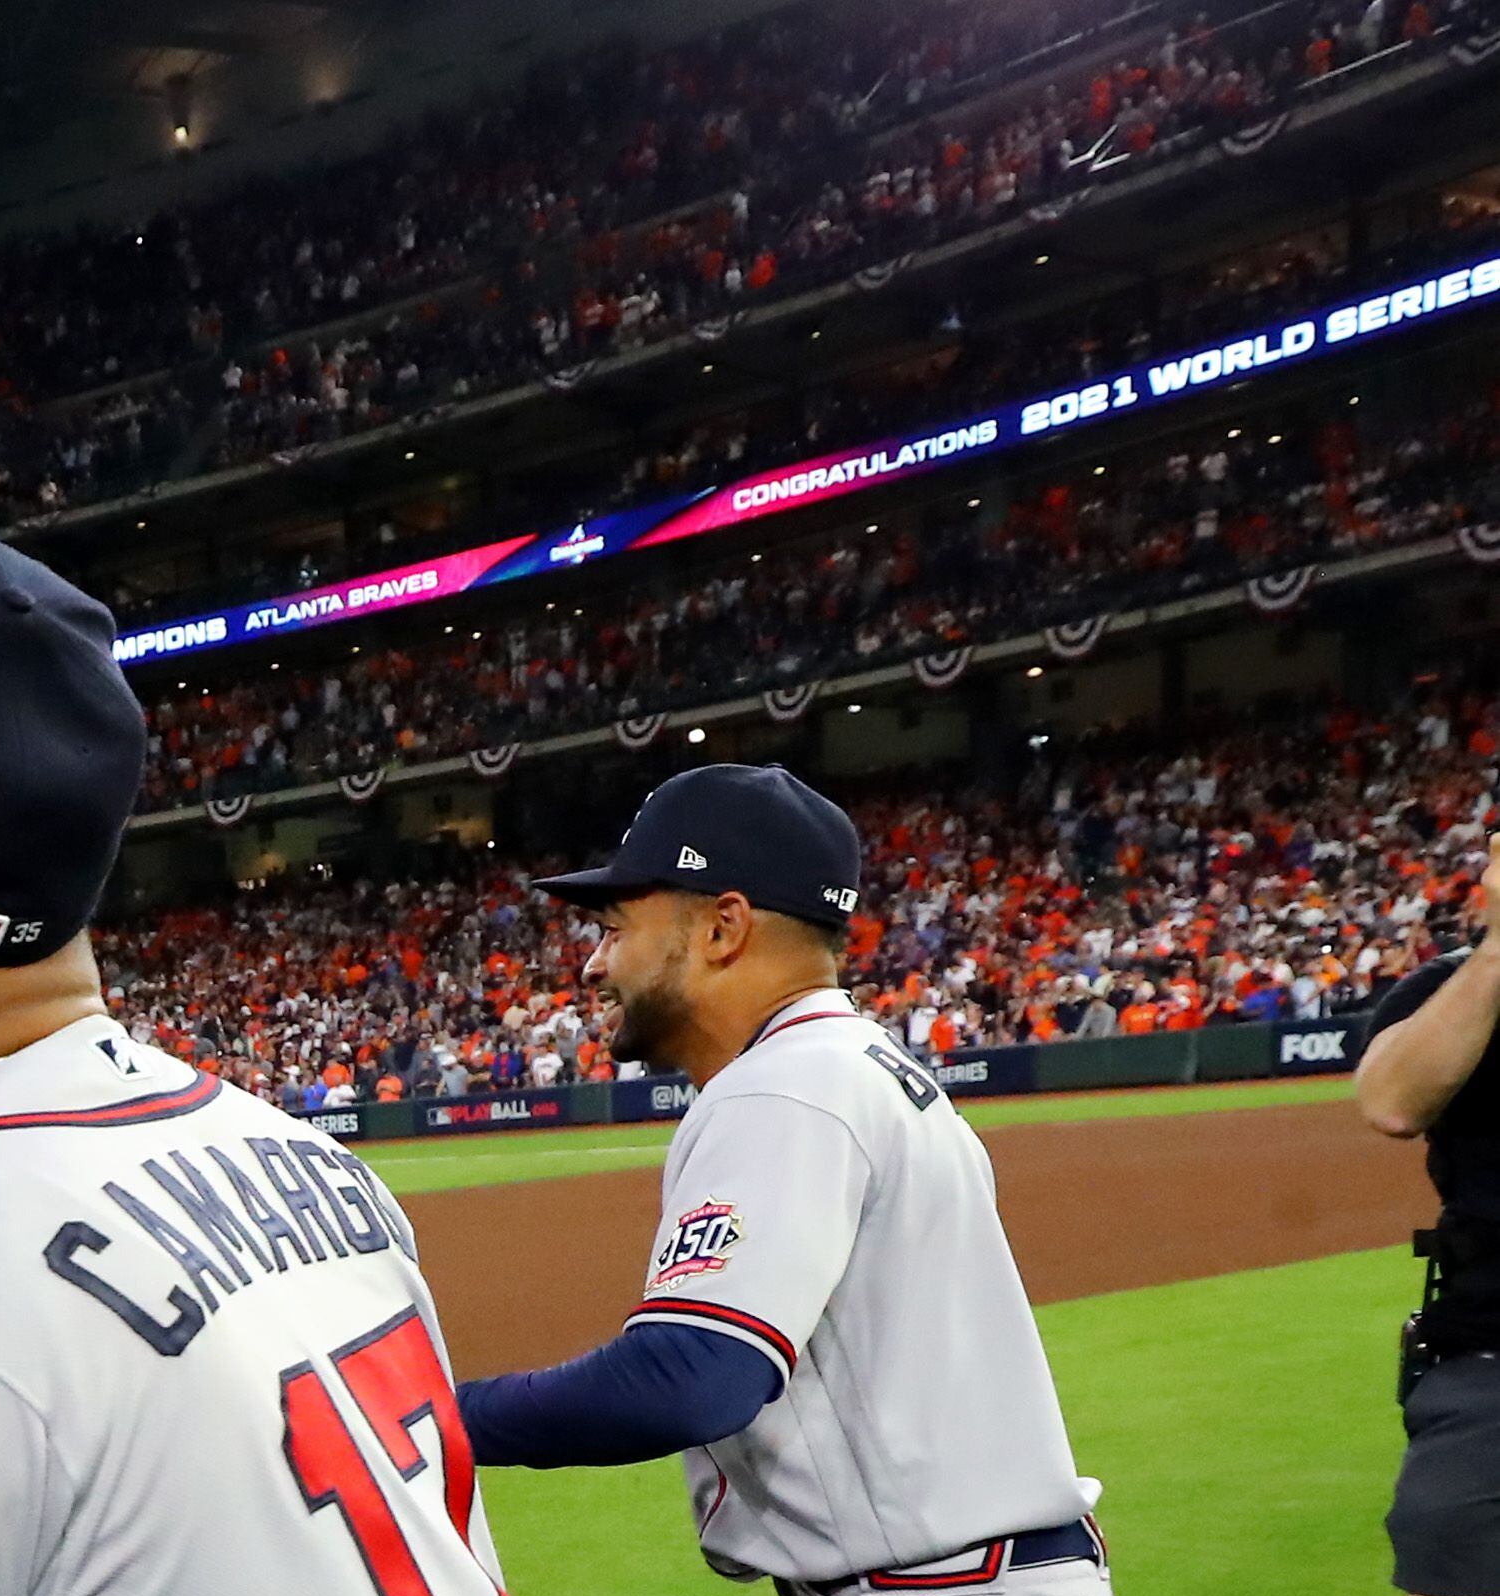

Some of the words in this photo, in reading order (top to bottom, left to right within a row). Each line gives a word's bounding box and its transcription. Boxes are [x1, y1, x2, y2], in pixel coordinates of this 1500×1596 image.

[731, 418, 998, 512] CONGRATULATIONS
[1019, 374, 1137, 436] 2021
[1147, 321, 1316, 398] WORLD
[1324, 257, 1500, 345] SERIES
[244, 593, 345, 632] ATLANTA
[347, 569, 439, 608] BRAVES
[10, 920, 43, 944] 35
[1280, 1029, 1347, 1066] FOX
[658, 1215, 732, 1272] 150
